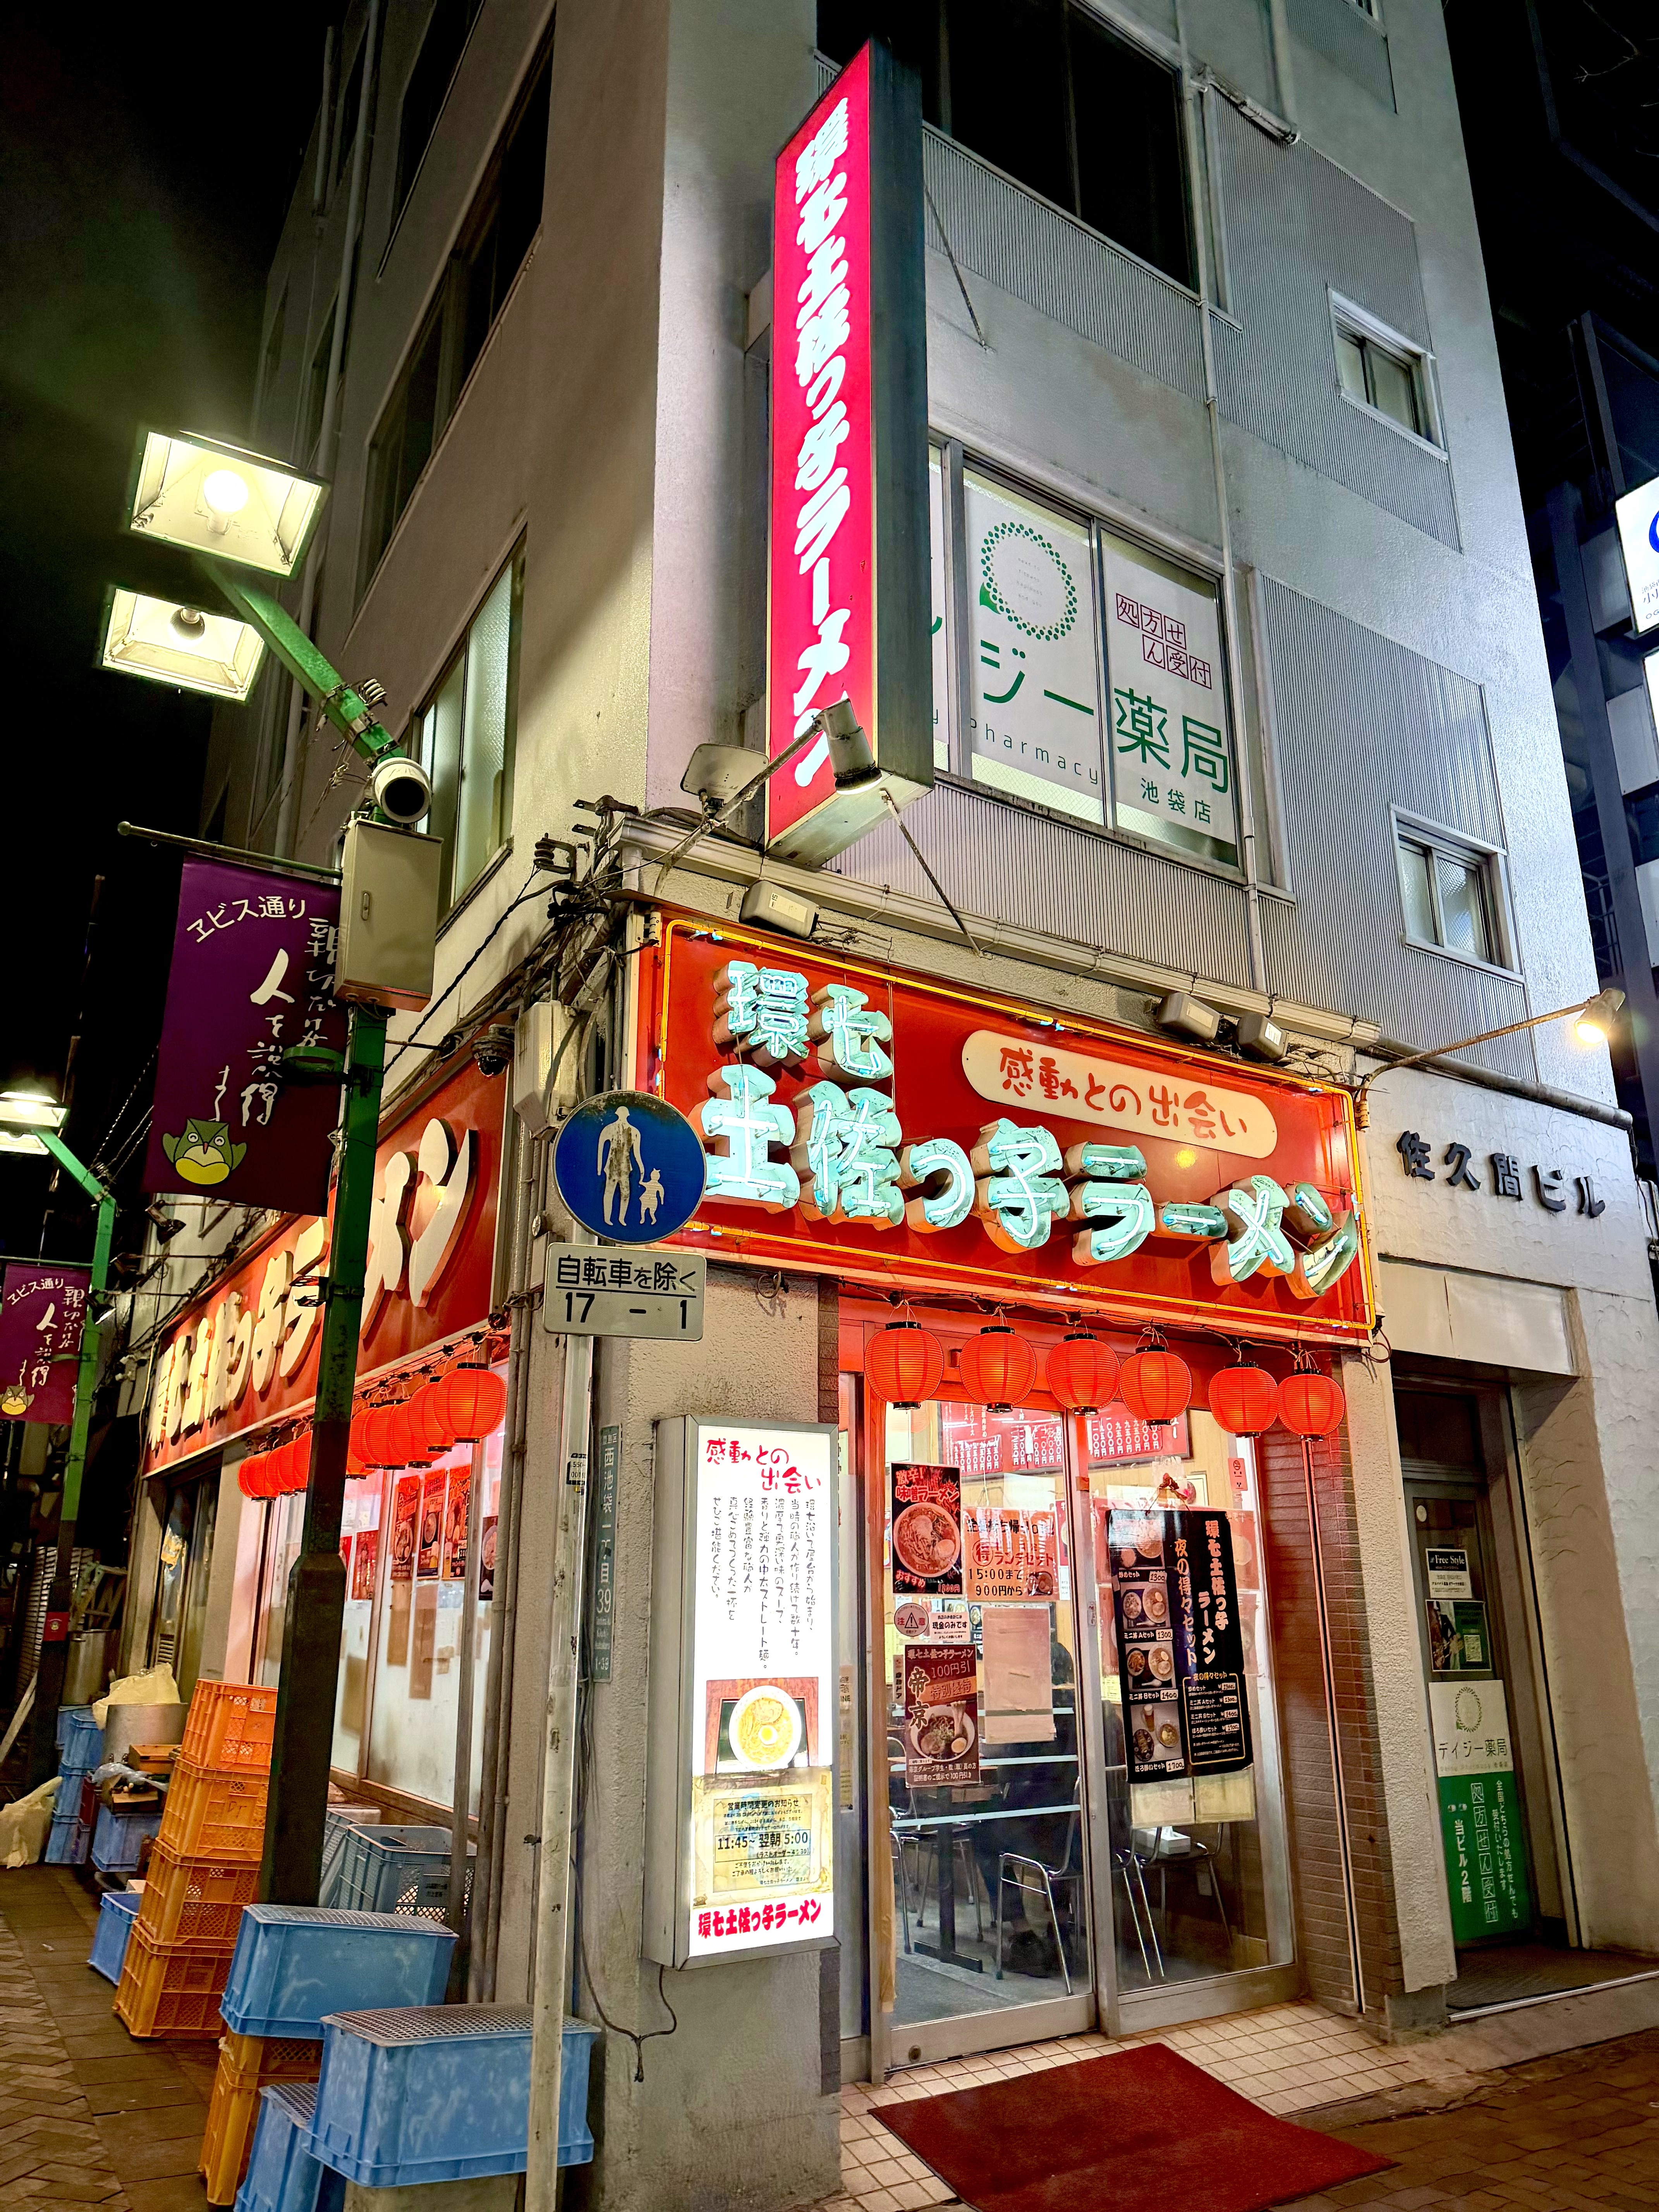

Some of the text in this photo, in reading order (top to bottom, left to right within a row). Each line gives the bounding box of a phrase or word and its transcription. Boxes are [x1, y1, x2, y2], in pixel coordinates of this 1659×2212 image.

[1141, 778, 1212, 824] 池袋店
[713, 960, 894, 1085] 環七
[999, 1046, 1249, 1140] 感動との出会い
[690, 1063, 1358, 1300] 土佐っ子ラーメン
[1396, 1130, 1606, 1219] 佐久間ビル
[149, 1118, 476, 1451] 環七土佐っ子ラメン
[557, 1254, 696, 1292] 自転車を除く
[706, 1437, 789, 1465] 感動との
[761, 1466, 821, 1494] 出会い
[895, 1485, 960, 1503] 味噌ラーメン
[895, 1569, 926, 1588] おすすめ
[1205, 1520, 1229, 1630] 環七土佐っ子
[1435, 1554, 1465, 1565] Free Style
[596, 1589, 611, 1614] 39
[975, 1585, 1023, 1596] 900円から
[1174, 1538, 1198, 1667] 夜の得々セット
[932, 1621, 968, 1630] 現金のみです
[1198, 1591, 1216, 1665] ラーメン
[908, 1667, 930, 1730] 帝京
[758, 1832, 781, 1848] 翌朝
[698, 1899, 822, 1939] 環七土佐っ子ラーメン
